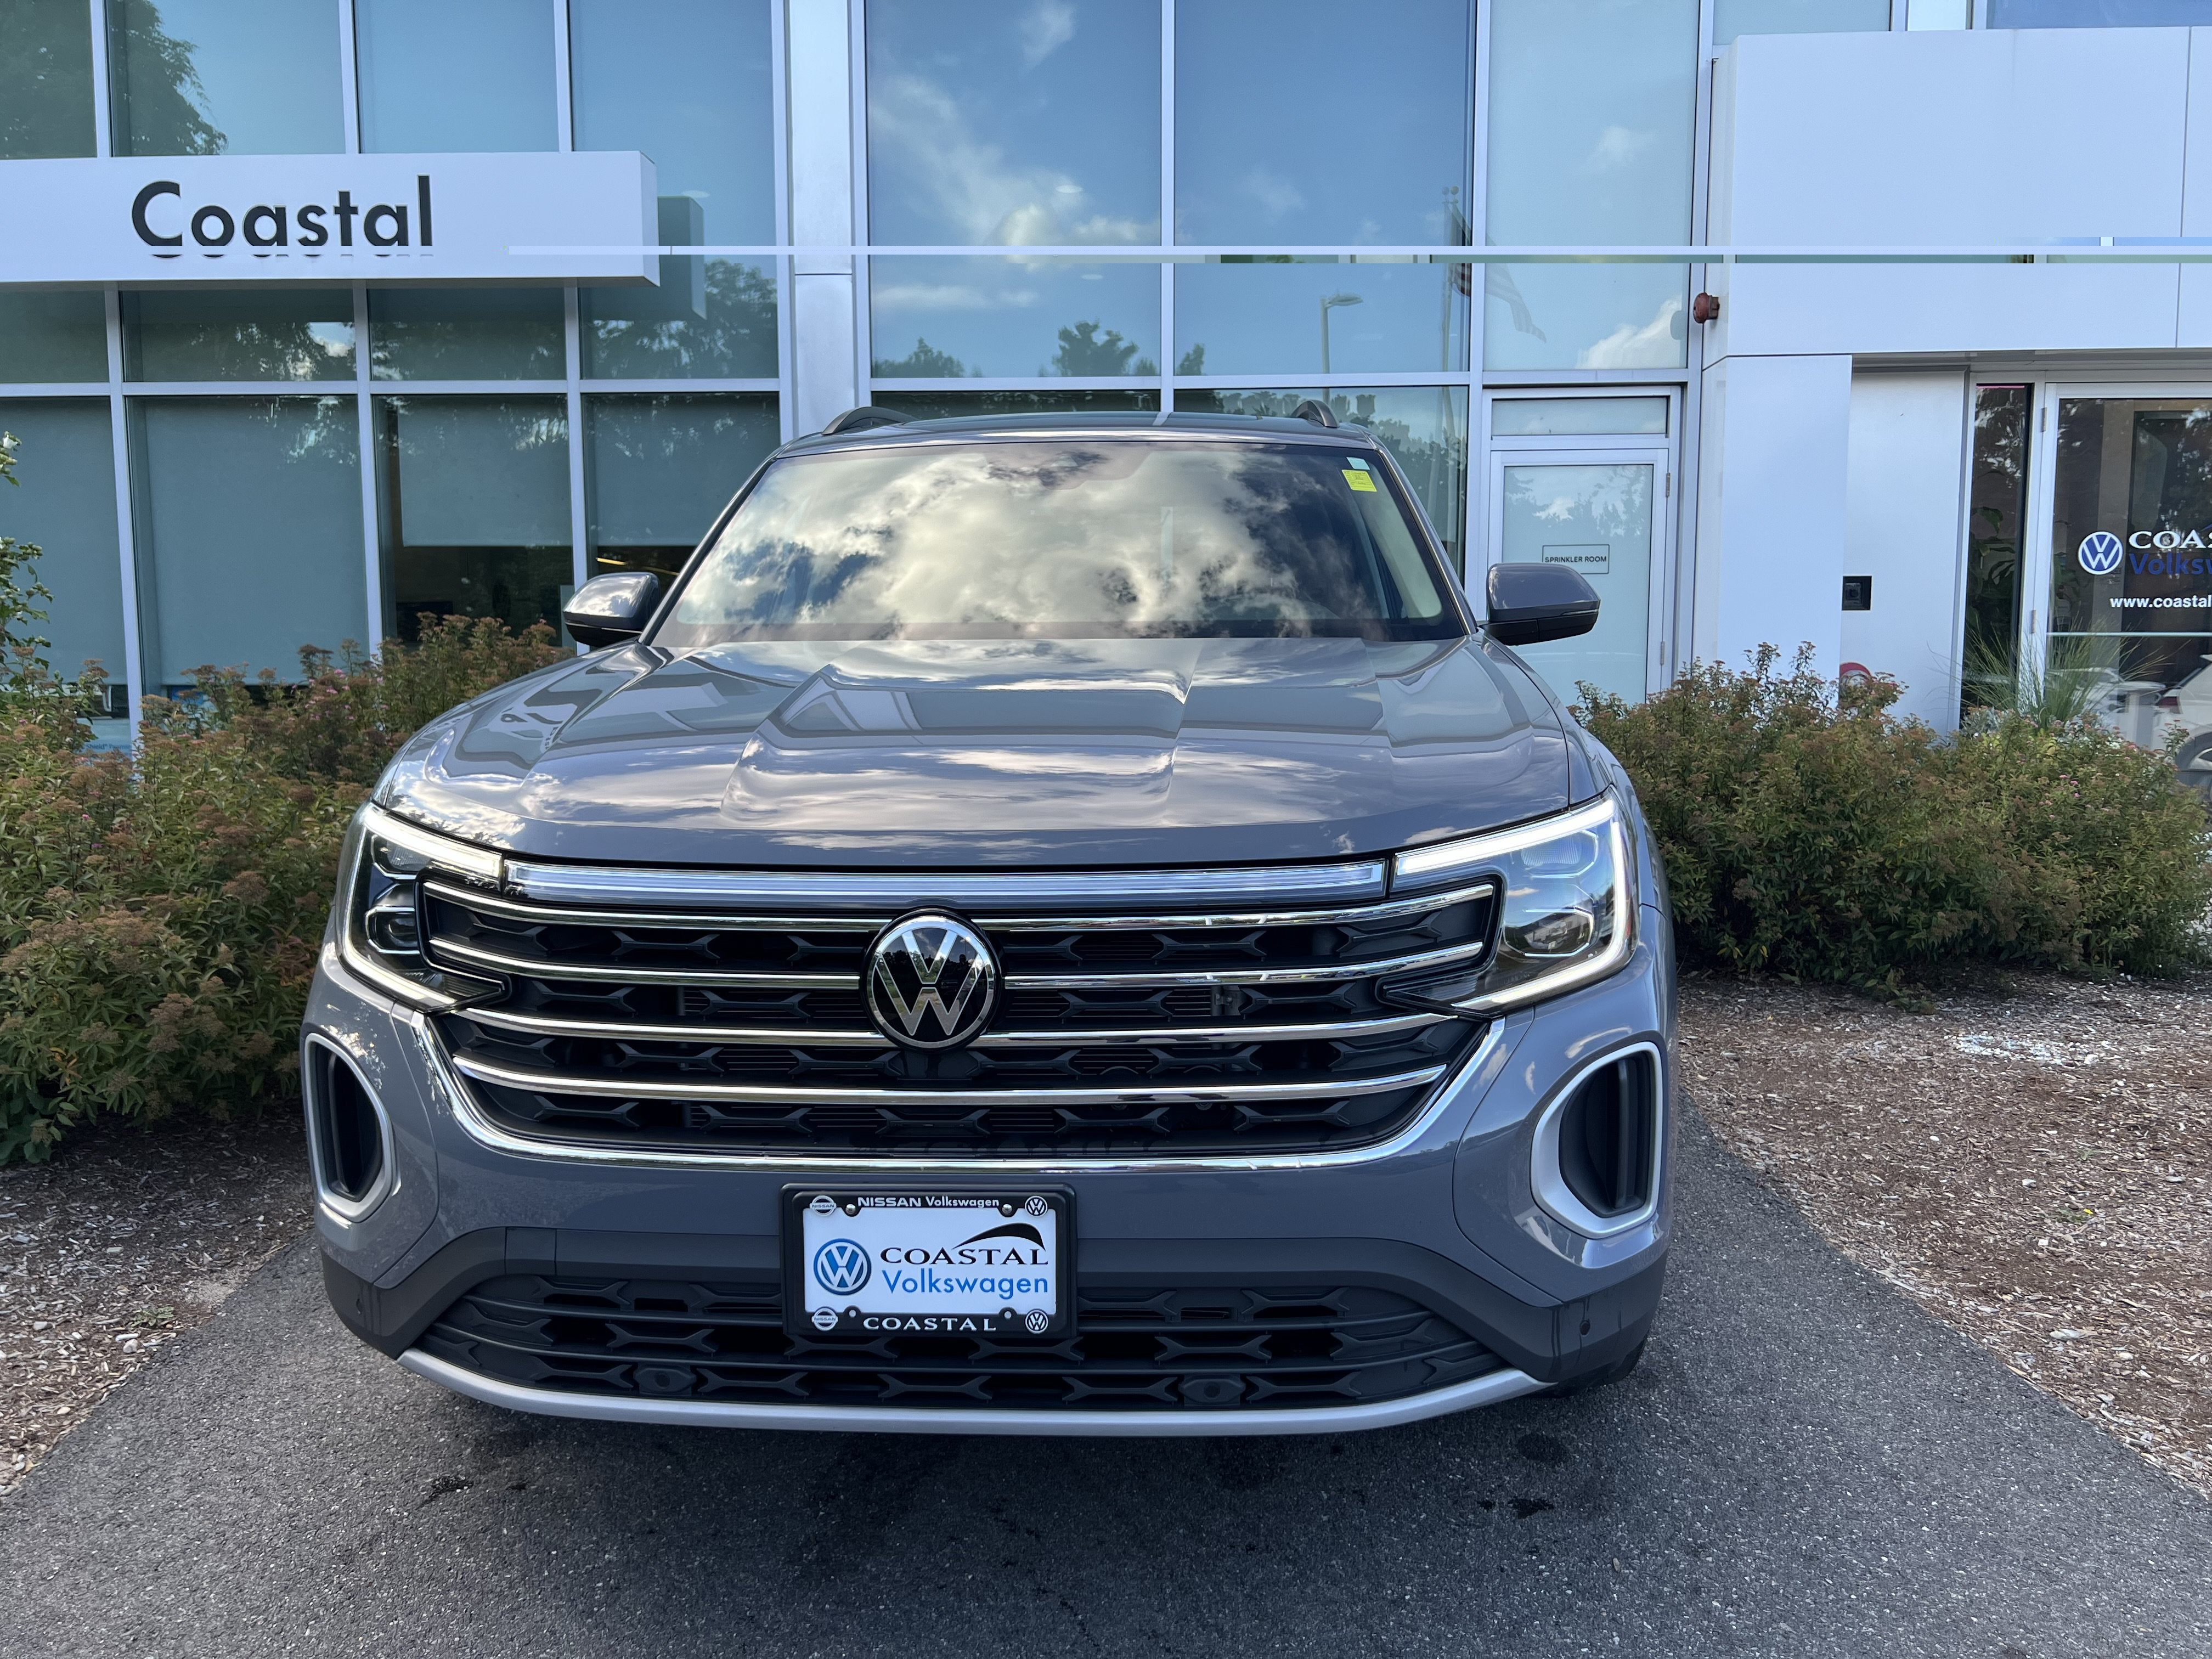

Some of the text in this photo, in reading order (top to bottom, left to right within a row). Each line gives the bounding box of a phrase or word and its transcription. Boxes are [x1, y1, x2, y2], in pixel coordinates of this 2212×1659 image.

[131, 174, 433, 258] Coastal
[2129, 529, 2212, 549] COA
[2109, 595, 2212, 608] www.coastal
[871, 922, 990, 1040] VW
[857, 1195, 1000, 1208] NISSAN Volkswagen
[880, 1246, 1049, 1266] COASTAL
[882, 1268, 1048, 1300] Volkswagen
[863, 1317, 996, 1331] COASTAL
